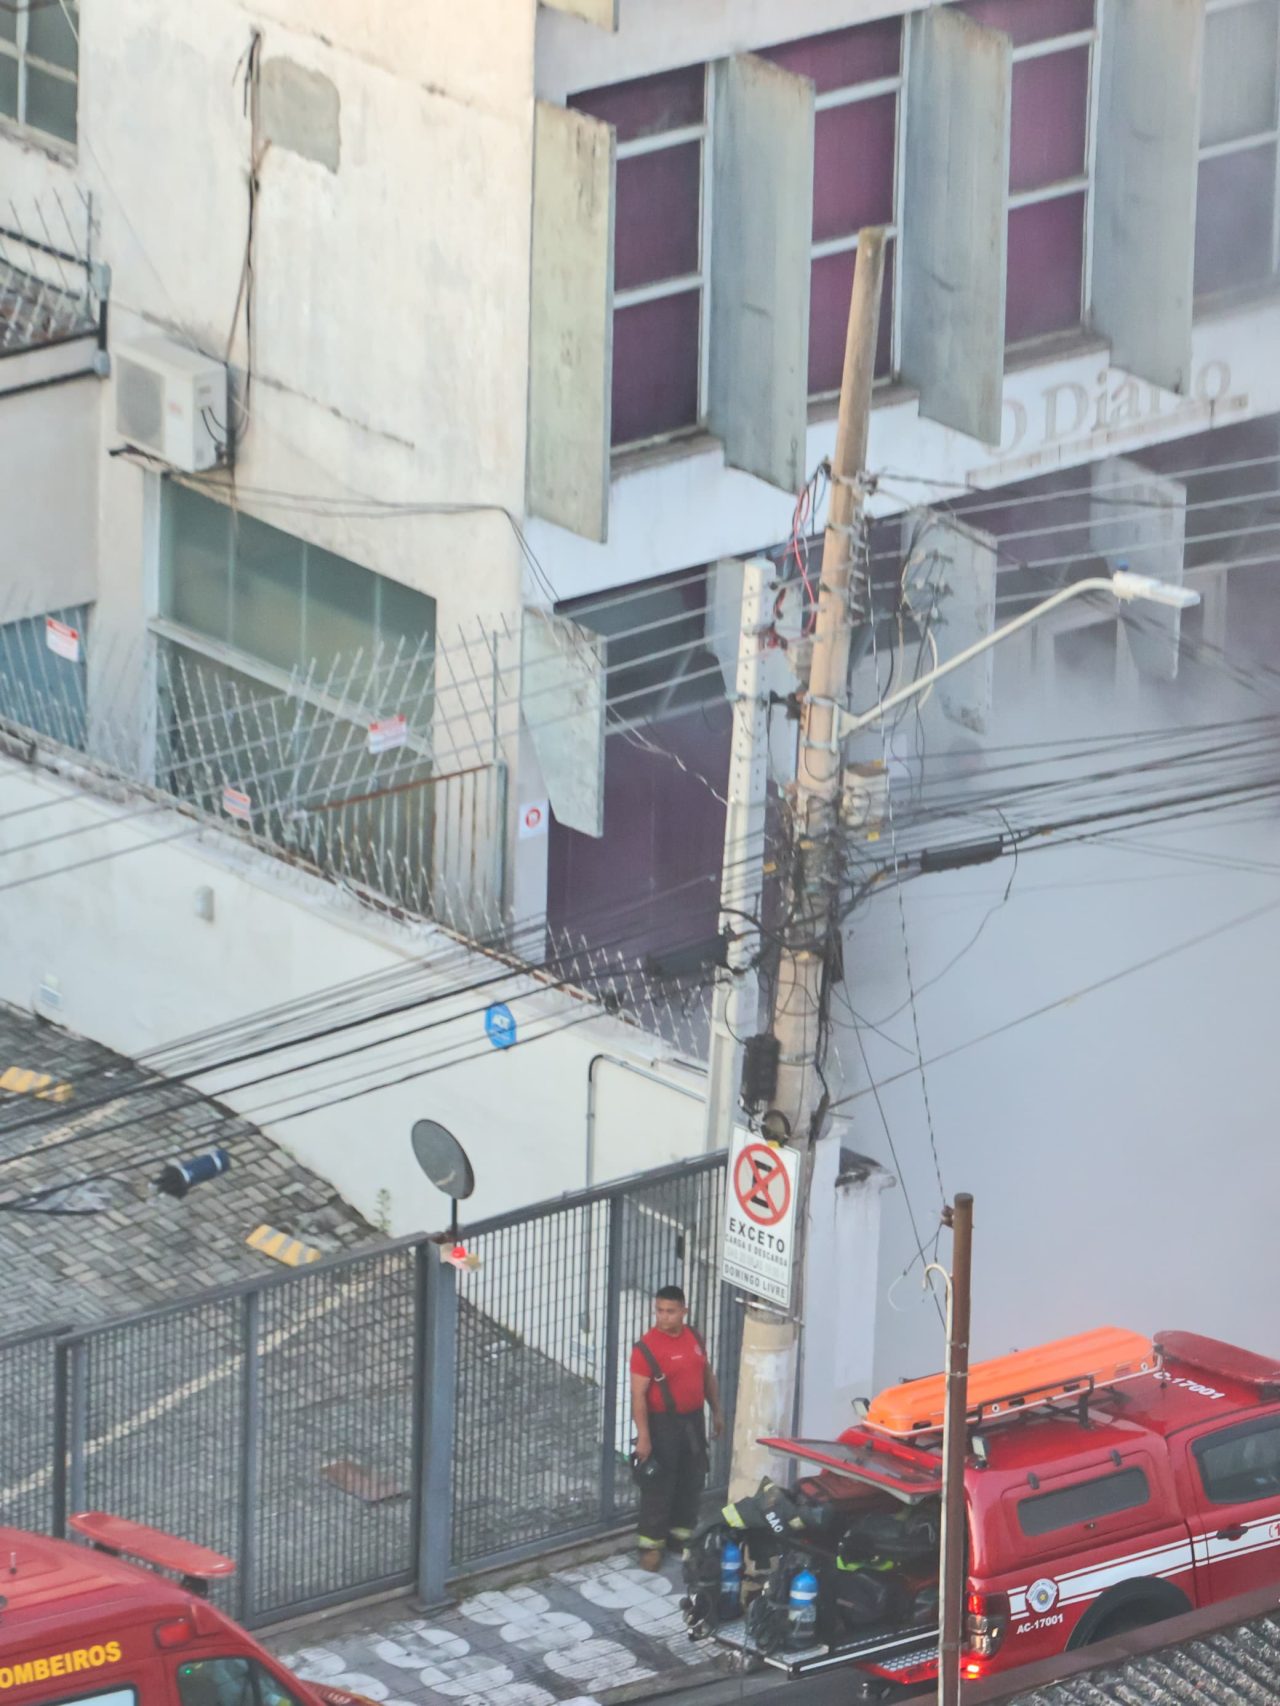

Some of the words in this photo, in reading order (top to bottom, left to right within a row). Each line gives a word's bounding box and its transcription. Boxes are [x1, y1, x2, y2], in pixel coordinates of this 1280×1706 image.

[729, 1217, 785, 1253] EXCETO
[725, 1264, 760, 1287] DOMINGO
[762, 1280, 786, 1299] LIVRE
[1016, 1613, 1063, 1634] AC-17001
